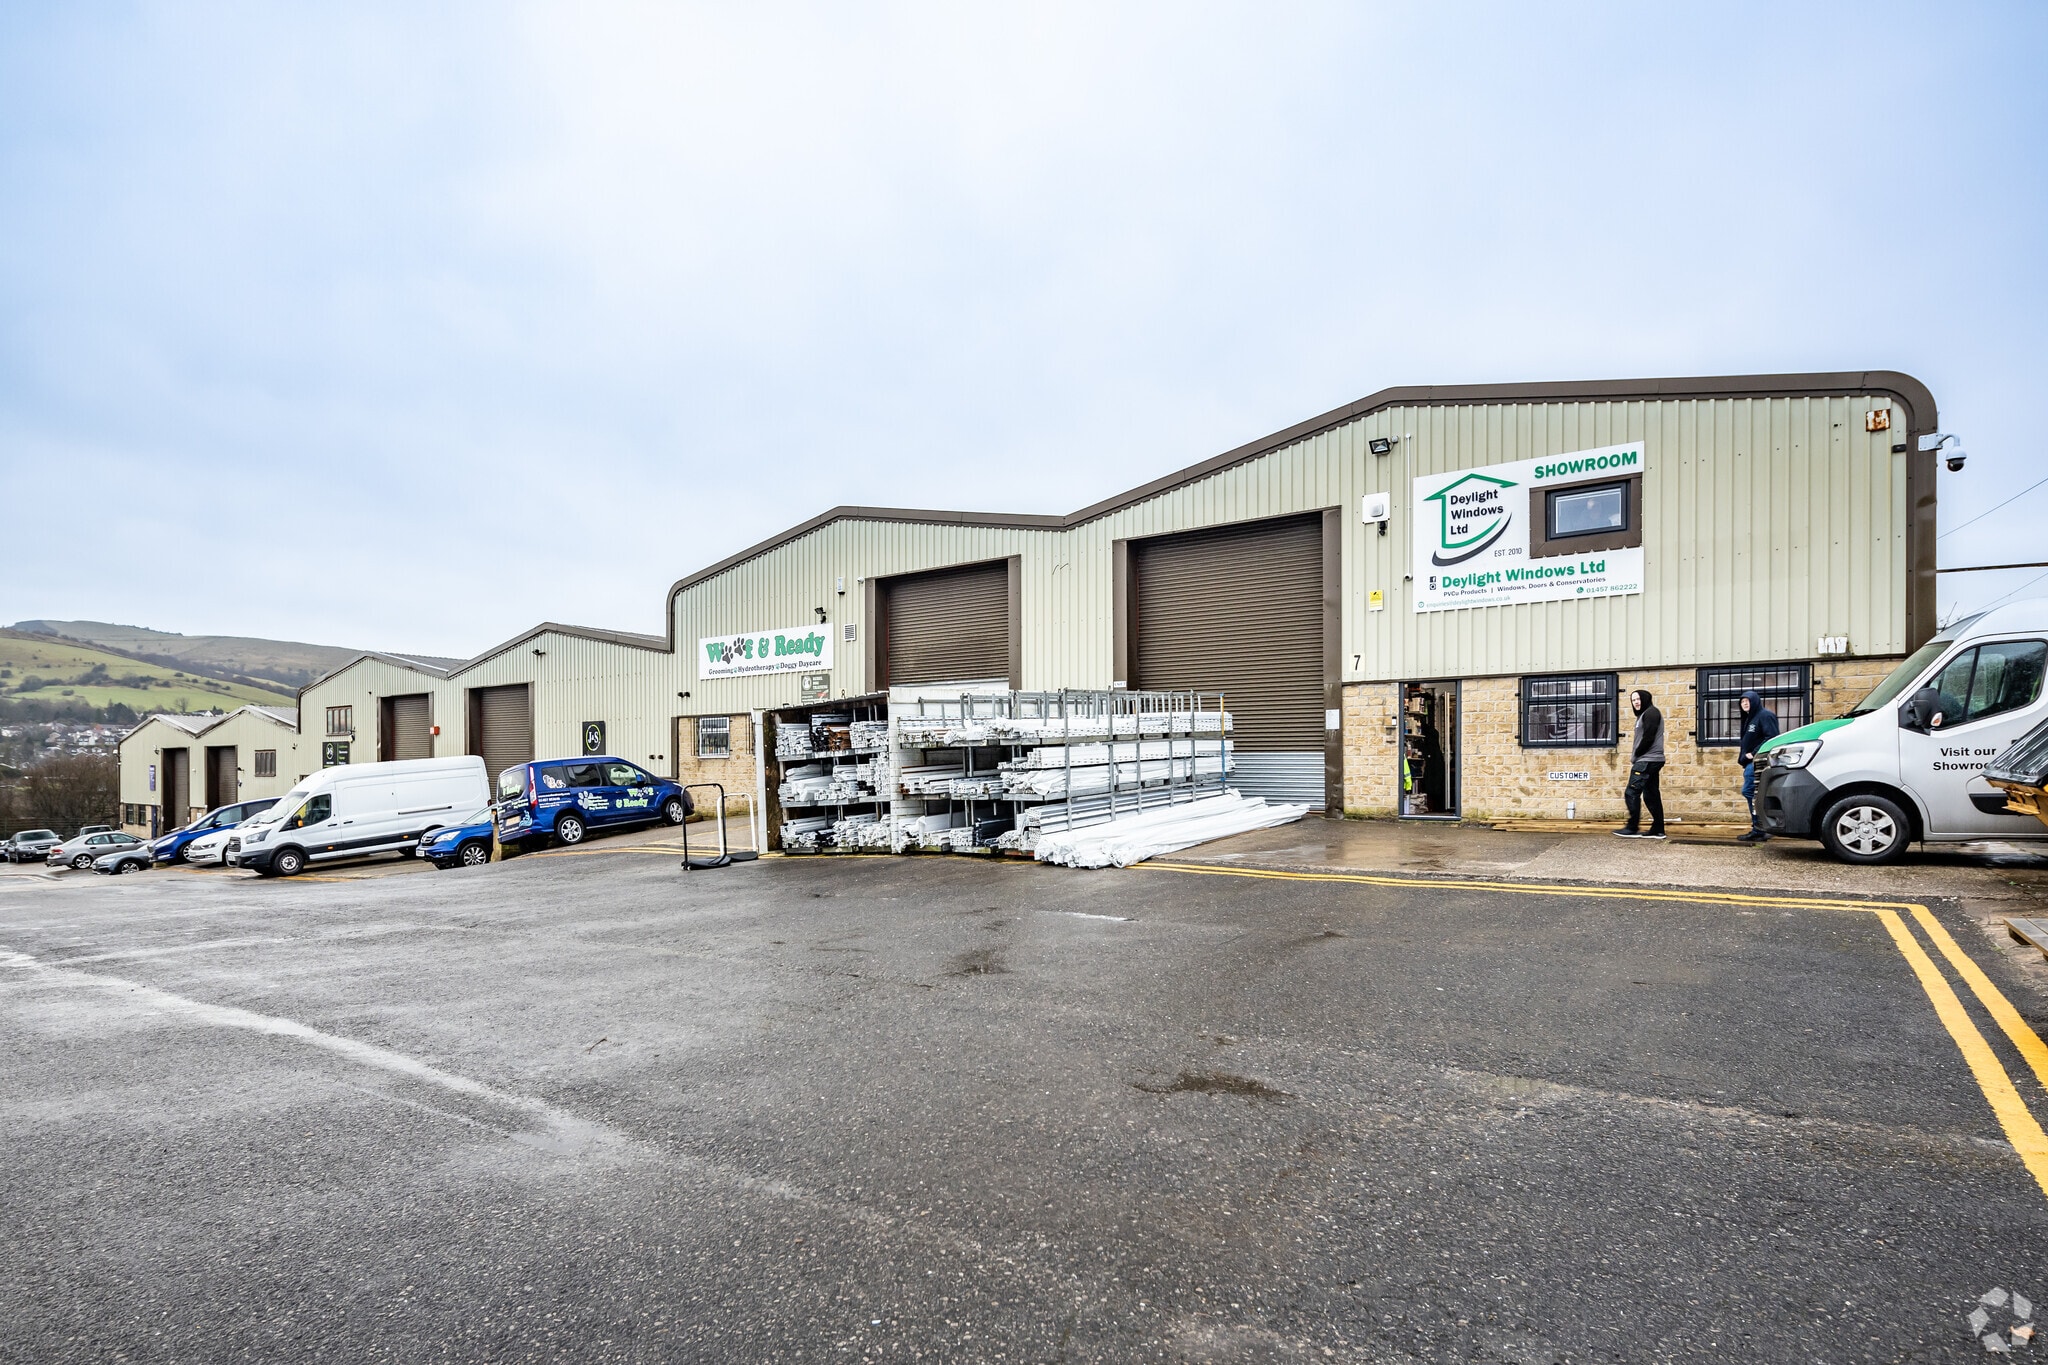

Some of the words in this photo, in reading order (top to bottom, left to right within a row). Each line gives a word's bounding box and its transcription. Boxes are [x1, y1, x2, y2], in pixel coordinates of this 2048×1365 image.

[1534, 451, 1637, 479] SHOWROOM
[1450, 489, 1498, 505] Deylight
[1451, 505, 1504, 520] Windows
[1450, 523, 1468, 535] Ltd
[1508, 547, 1523, 556] 2010
[1442, 571, 1502, 588] Deylight
[1505, 565, 1575, 582] Windows
[1580, 559, 1605, 574] Ltd
[1460, 588, 1488, 596] Products
[1556, 576, 1606, 586] Conservatories
[1610, 583, 1638, 591] 862222
[757, 637, 770, 658] &
[774, 631, 825, 657] Ready
[738, 664, 775, 673] Hydrotherapy
[780, 662, 797, 670] Doggy
[799, 660, 822, 668] Daycare
[1354, 655, 1361, 671] 7
[1940, 747, 1970, 756] Visit
[1974, 748, 1997, 756] our
[1933, 761, 1988, 771] Showro
